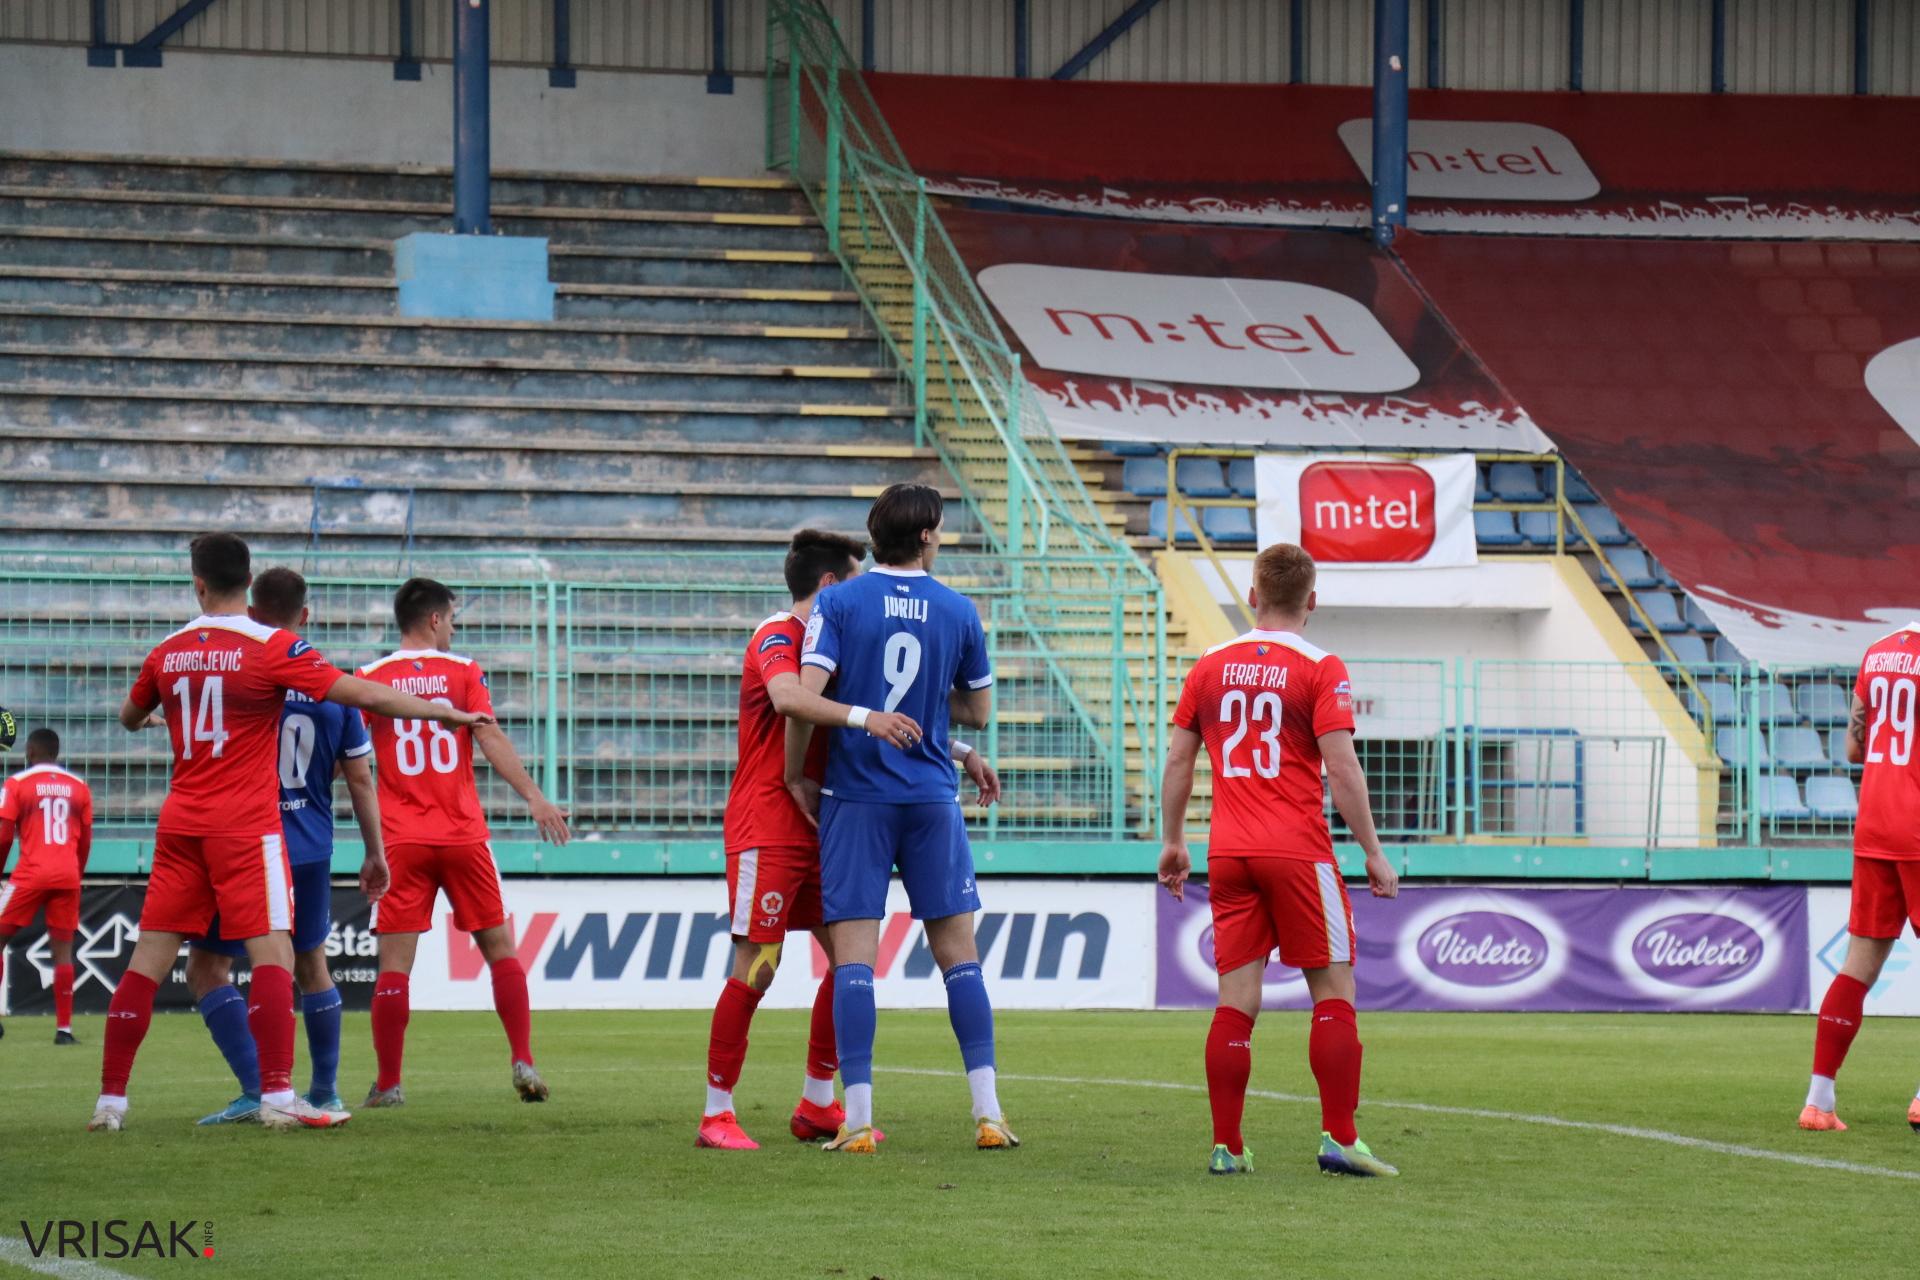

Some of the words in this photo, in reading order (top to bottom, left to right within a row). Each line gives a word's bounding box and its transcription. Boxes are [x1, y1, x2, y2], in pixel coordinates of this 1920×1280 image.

[1043, 307, 1355, 356] m:tel
[1314, 489, 1421, 530] m:tel
[884, 595, 928, 623] JURILJ
[162, 647, 243, 674] GEORGIJEVIĆ
[883, 631, 922, 713] 9
[1222, 663, 1288, 689] FERREYRA
[392, 675, 448, 696] RADOVAC
[172, 675, 229, 761] 14
[393, 697, 459, 776] 88
[1219, 689, 1283, 779] 23
[1867, 676, 1916, 767] 29
[278, 713, 316, 790] 0
[39, 798, 69, 846] 18
[324, 921, 378, 957] šta
[1431, 929, 1535, 966] Violeta
[1646, 930, 1750, 967] Violeta
[343, 969, 377, 983] 1323
